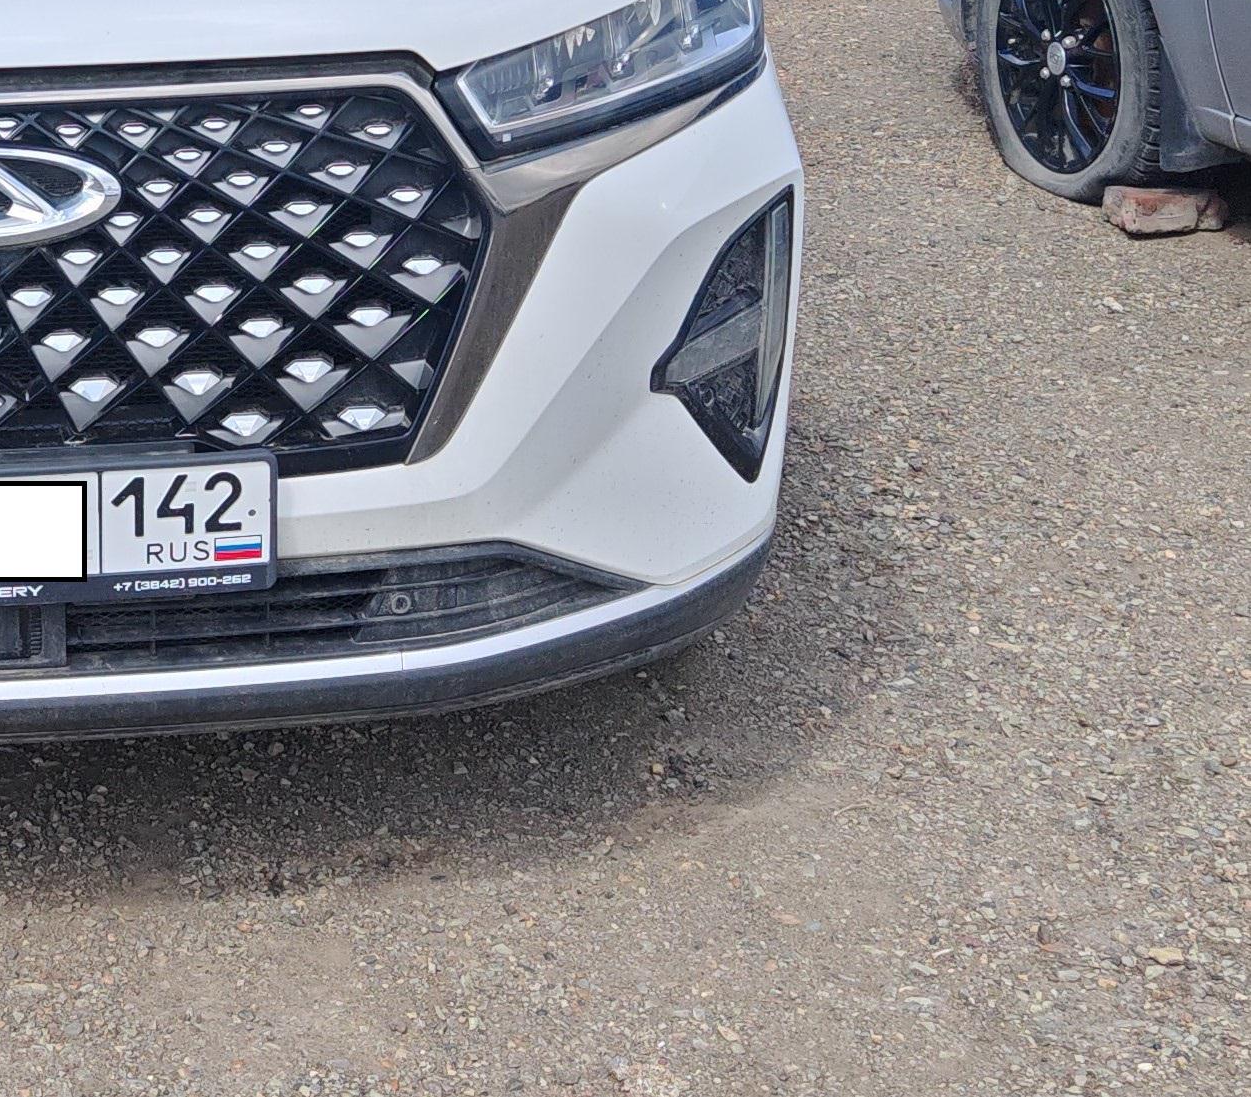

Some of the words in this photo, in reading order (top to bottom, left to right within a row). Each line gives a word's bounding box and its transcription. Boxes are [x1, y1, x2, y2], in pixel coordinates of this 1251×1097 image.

[111, 471, 242, 537] 142
[146, 540, 210, 564] RUS
[112, 582, 133, 592] +7
[135, 578, 186, 591] (3842)
[188, 574, 252, 588] 900-262
